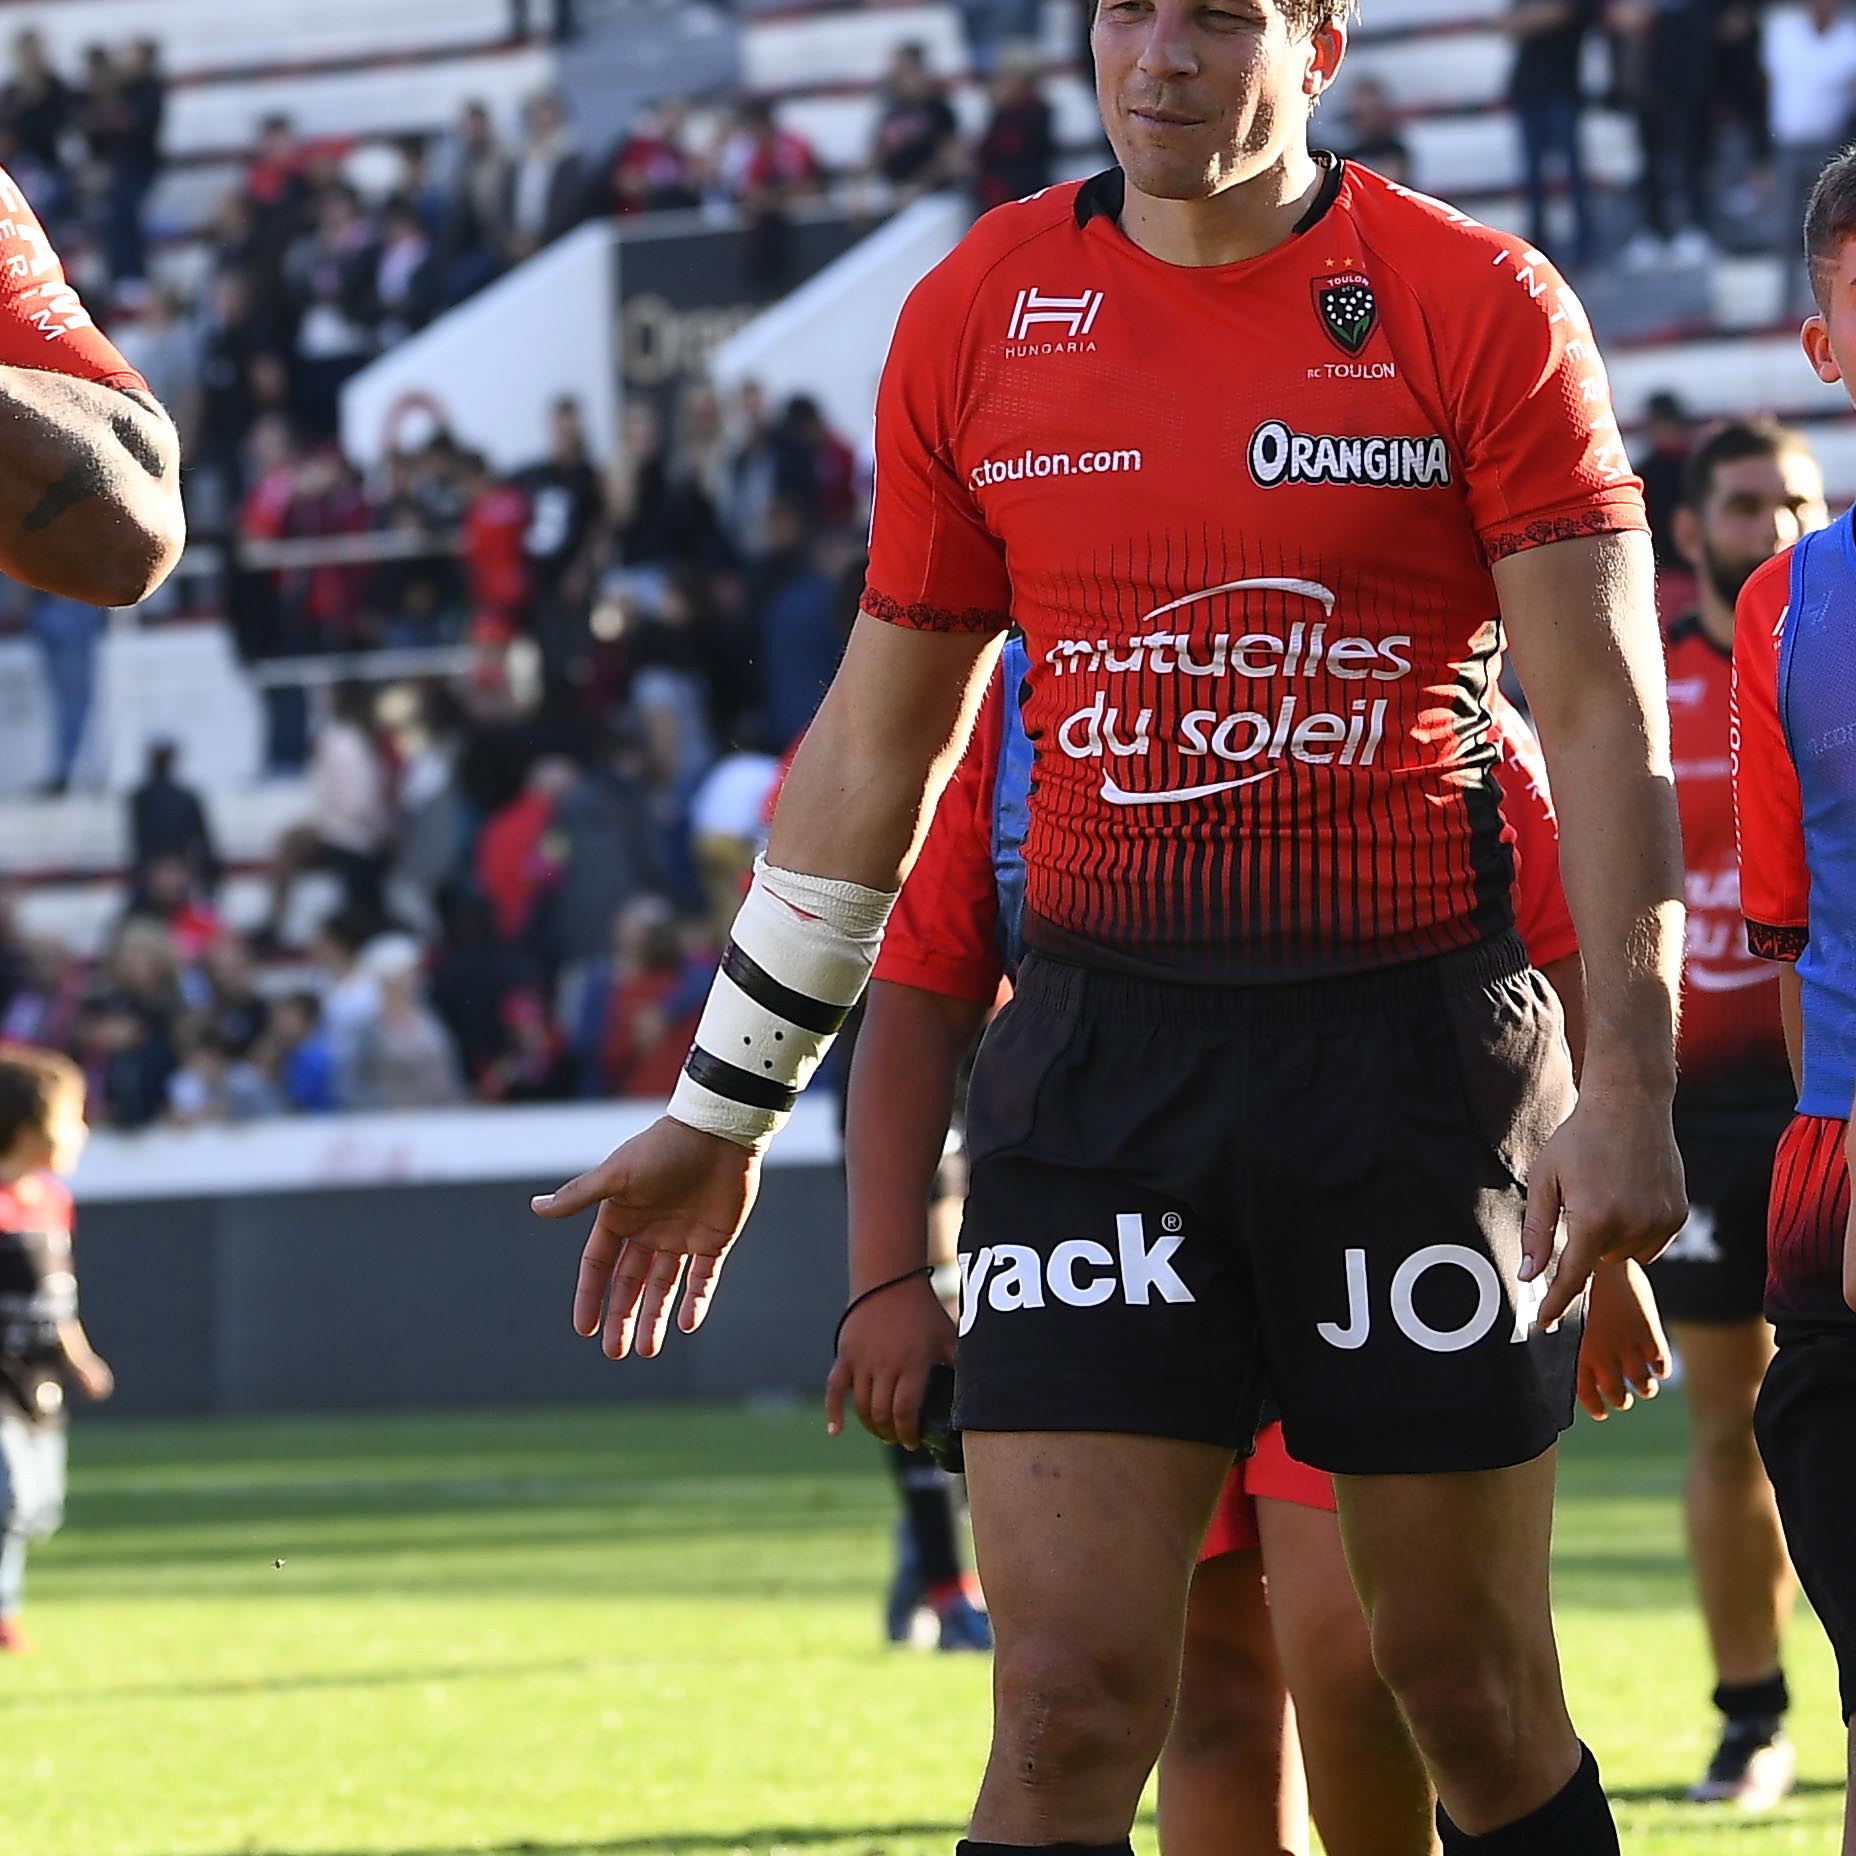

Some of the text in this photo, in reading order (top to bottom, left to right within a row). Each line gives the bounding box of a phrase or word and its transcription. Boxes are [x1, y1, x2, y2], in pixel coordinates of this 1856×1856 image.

[1327, 275, 1370, 287] TOULON
[1005, 341, 1097, 359] HUNGARIA
[1307, 362, 1395, 379] RC TOULON
[1046, 622, 1412, 681] mutuelles
[1058, 690, 1388, 766] du soleil
